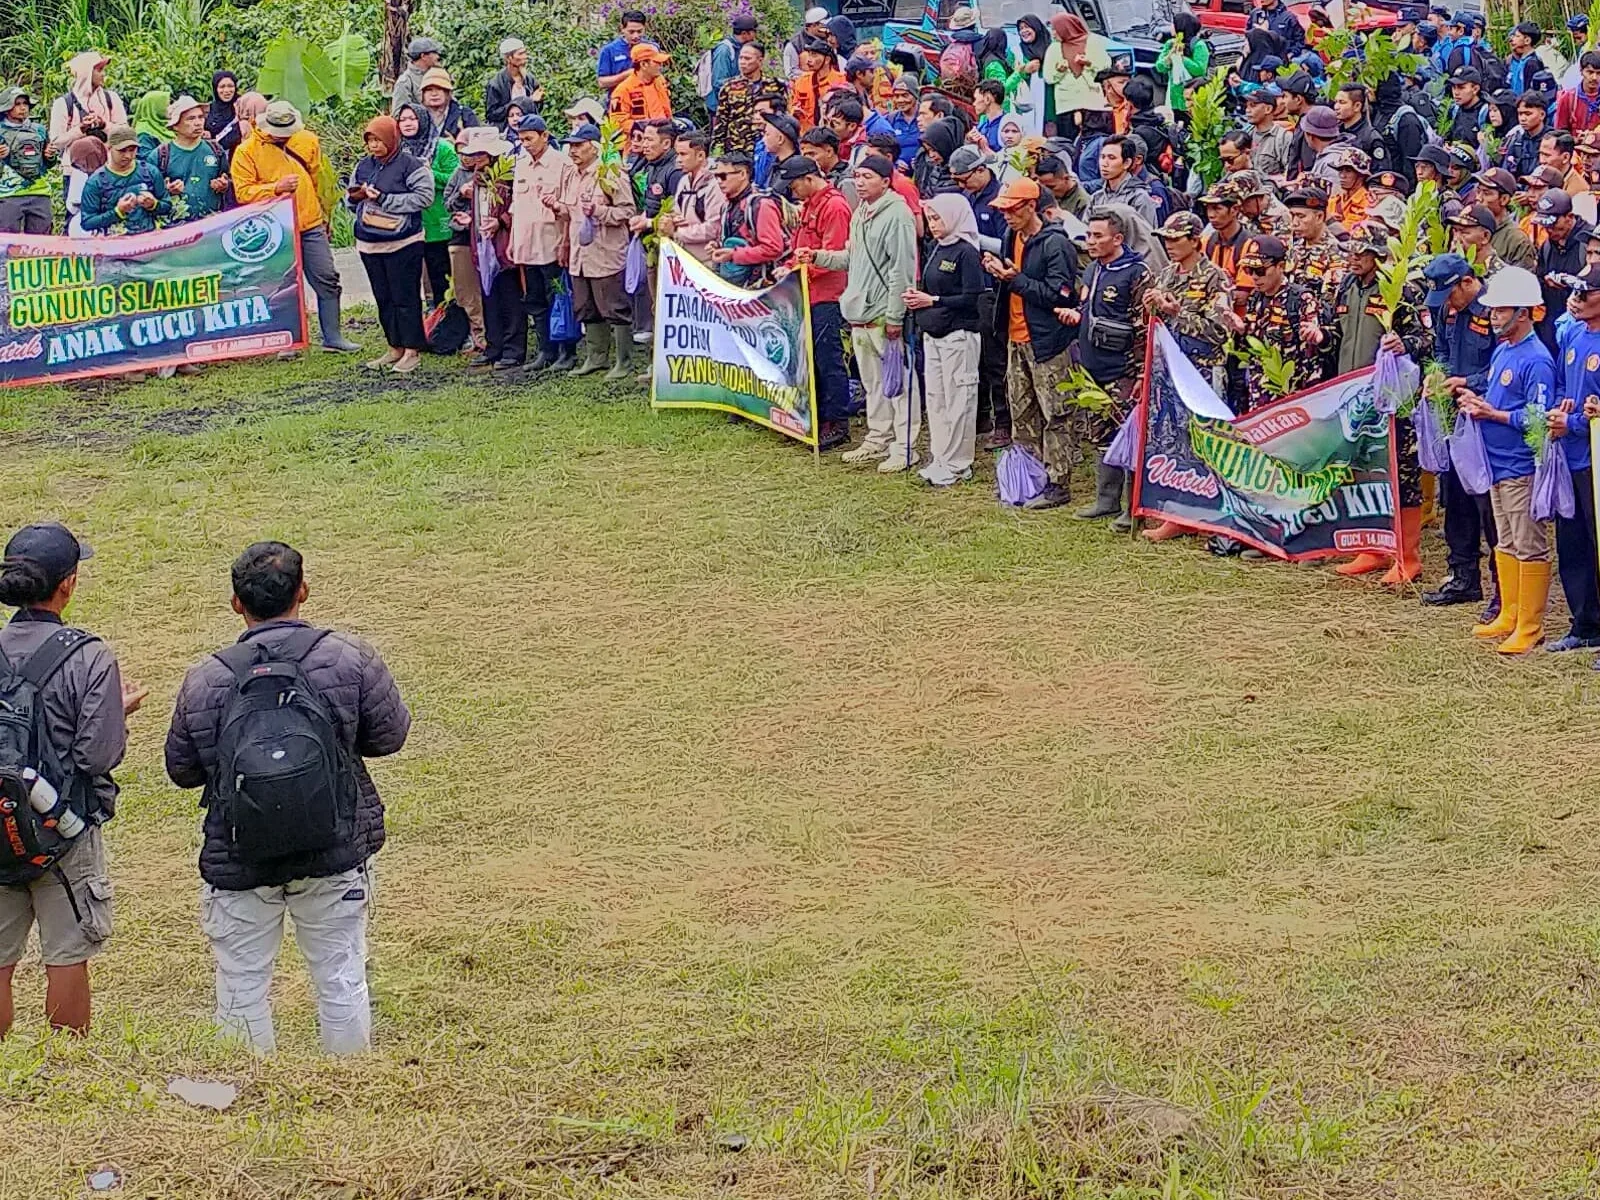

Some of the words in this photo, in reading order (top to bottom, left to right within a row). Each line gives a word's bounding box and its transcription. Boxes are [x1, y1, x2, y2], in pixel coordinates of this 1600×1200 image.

[8, 256, 94, 291] HUTAN
[11, 284, 116, 328] GUNUNG
[119, 271, 222, 314] SLAMET
[47, 323, 124, 365] ANAK
[129, 308, 197, 347] CUCU
[203, 294, 272, 334] KITA
[667, 355, 717, 386] YANG
[1147, 455, 1219, 499] Untuk
